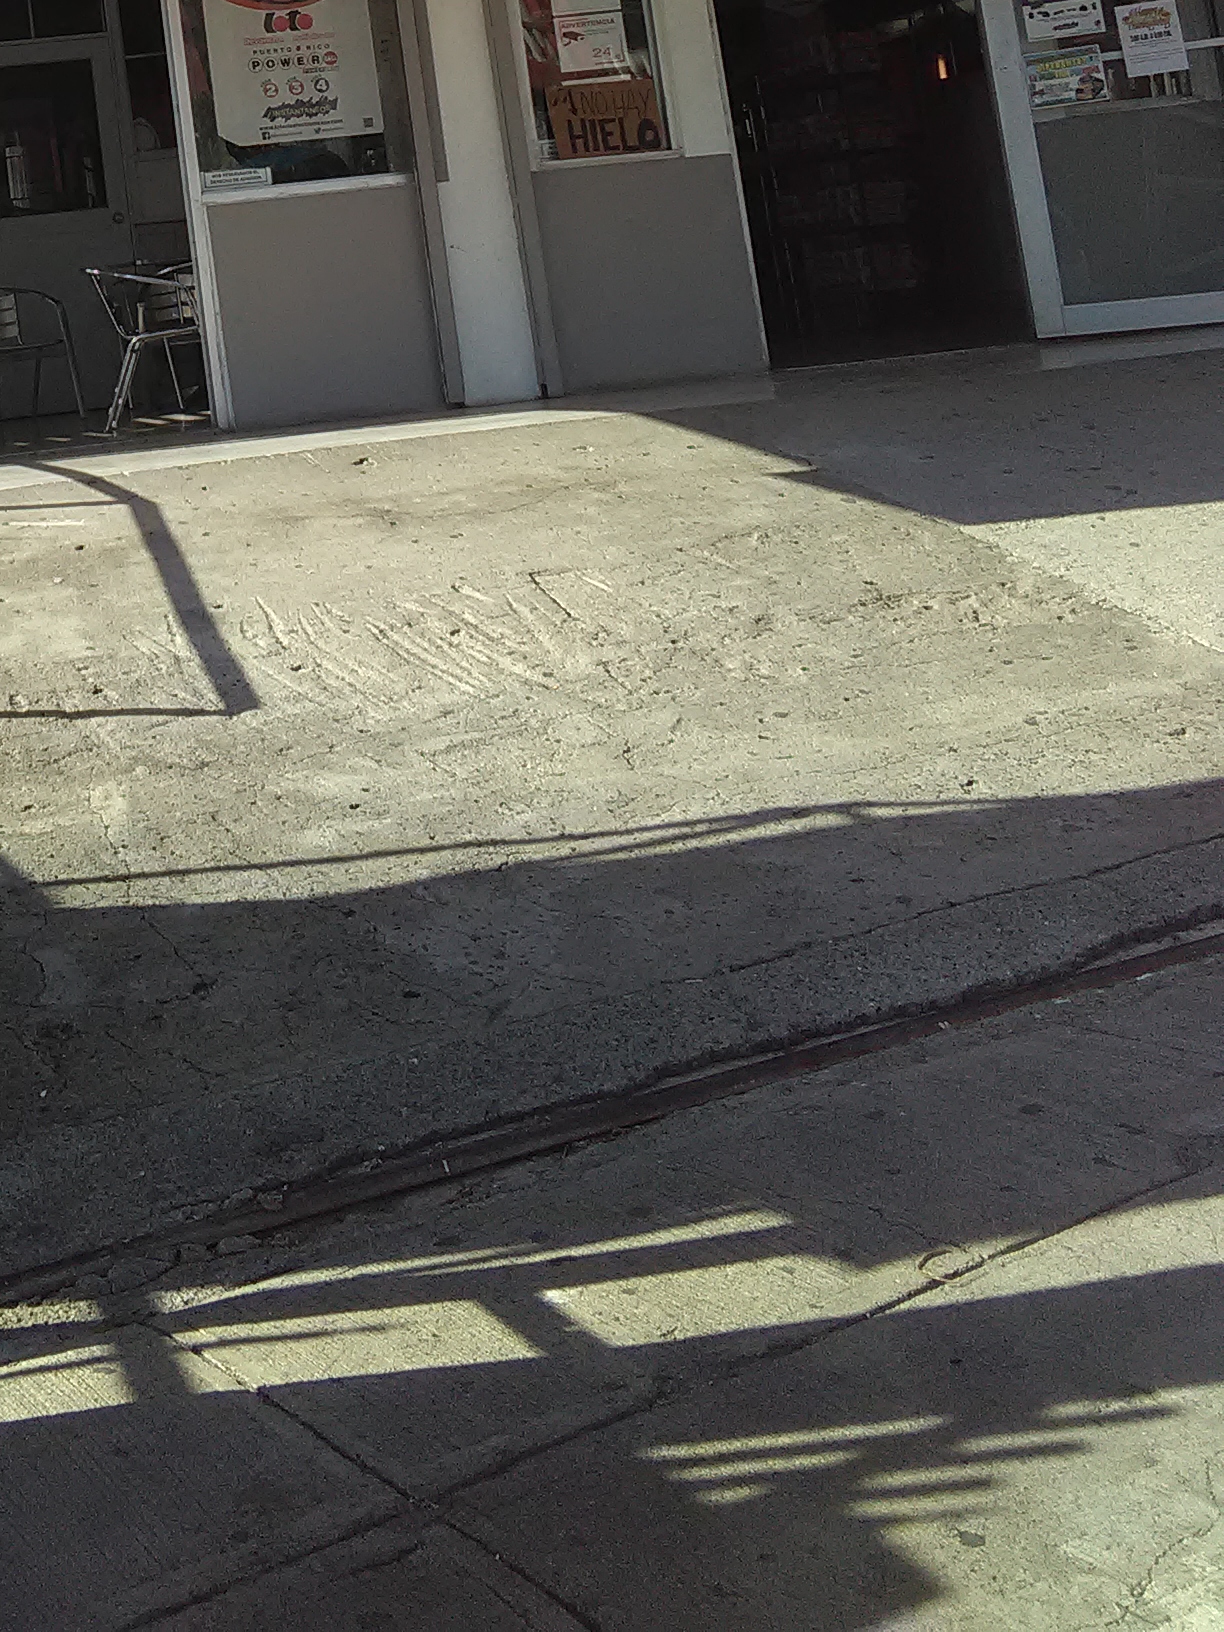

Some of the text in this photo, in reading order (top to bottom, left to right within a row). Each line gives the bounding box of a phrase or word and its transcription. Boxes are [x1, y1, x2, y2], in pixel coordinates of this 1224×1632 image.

[592, 47, 612, 59] 24
[580, 90, 608, 115] NO
[568, 118, 661, 154] HIELO
